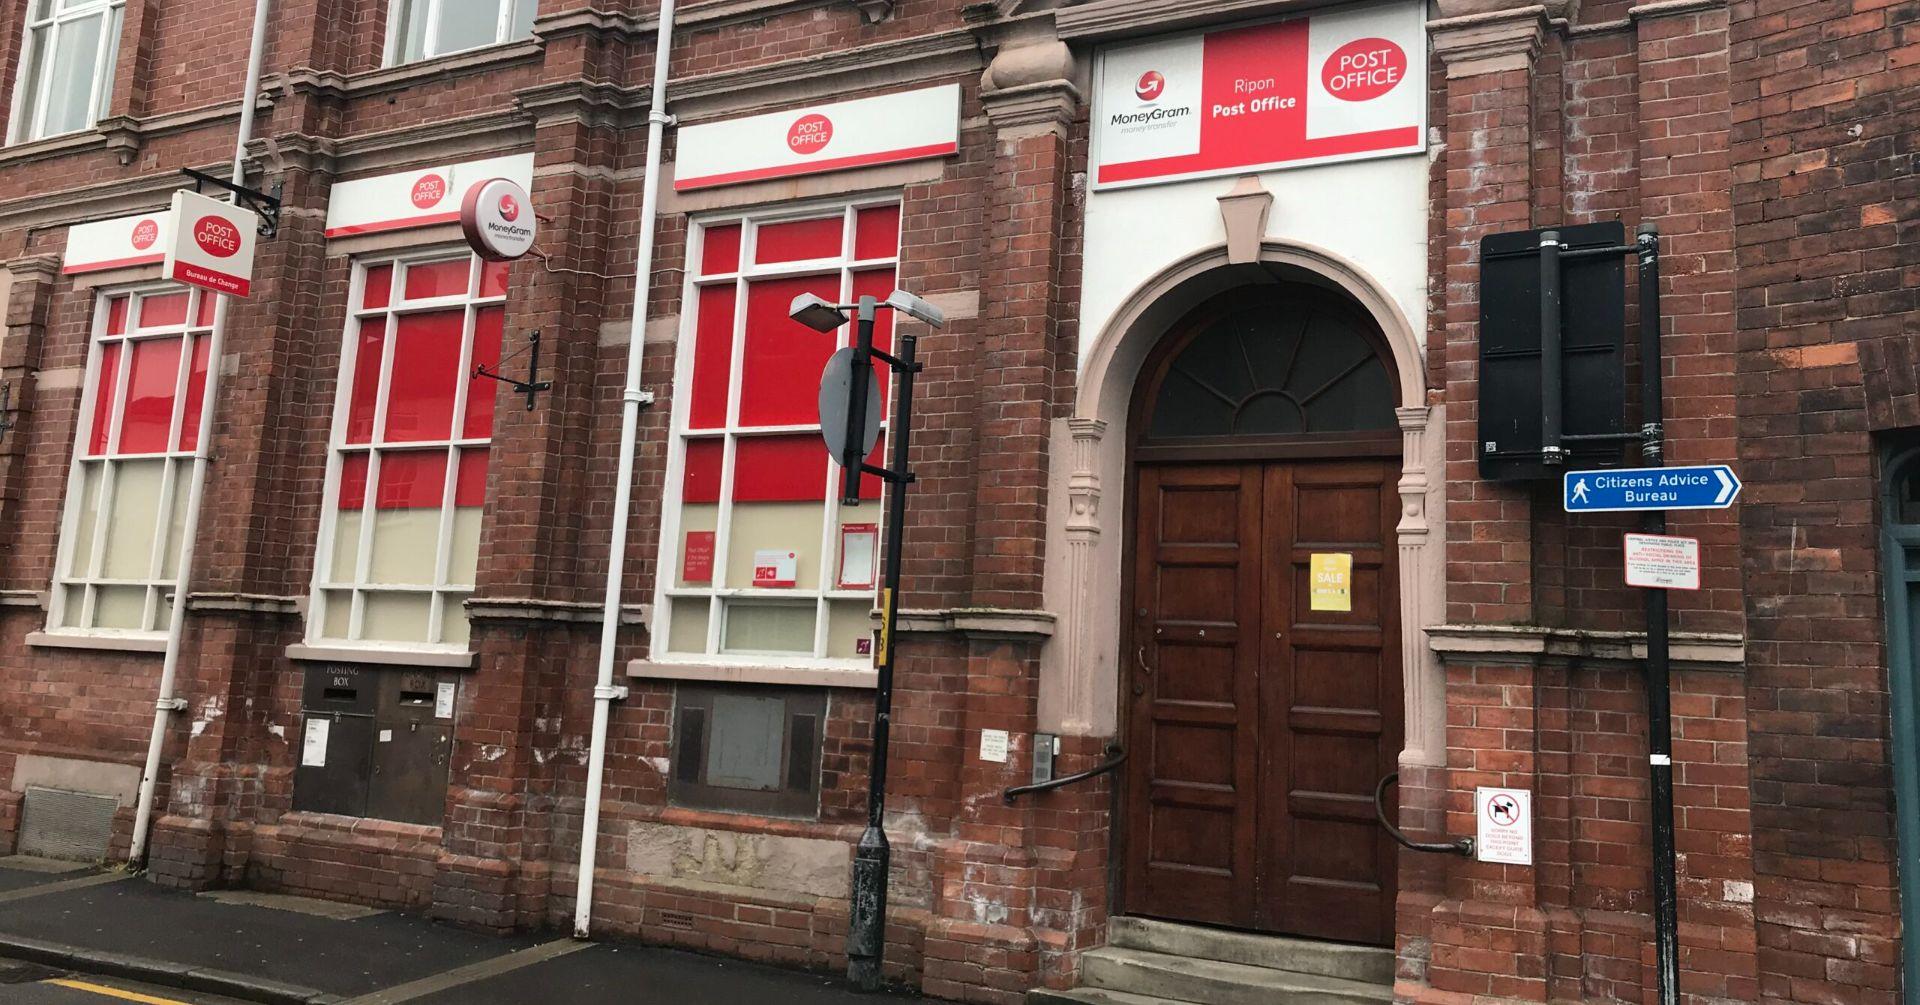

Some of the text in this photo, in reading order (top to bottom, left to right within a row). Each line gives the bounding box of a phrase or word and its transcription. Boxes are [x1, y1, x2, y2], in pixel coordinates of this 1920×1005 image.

[1340, 49, 1392, 71] POST
[1330, 66, 1397, 91] OFFICE
[1234, 78, 1275, 94] Ripon
[1212, 96, 1296, 118] Post Office
[1110, 106, 1190, 125] MoneyGram
[798, 121, 825, 134] POST
[791, 132, 827, 146] OFFICE
[419, 180, 439, 192] POST
[413, 190, 441, 201] OFFICE
[138, 224, 154, 234] POST
[205, 221, 233, 238] POST
[488, 223, 531, 236] MoneyGram
[133, 233, 155, 244] OFFICE
[197, 231, 235, 251] OFFICE
[186, 269, 239, 290] Bureau de Change
[1595, 474, 1708, 488] Citizens Advice
[1625, 490, 1677, 502] Bureau
[1317, 572, 1344, 584] SALE
[326, 664, 359, 676] POSTING
[333, 677, 349, 687] BOX
